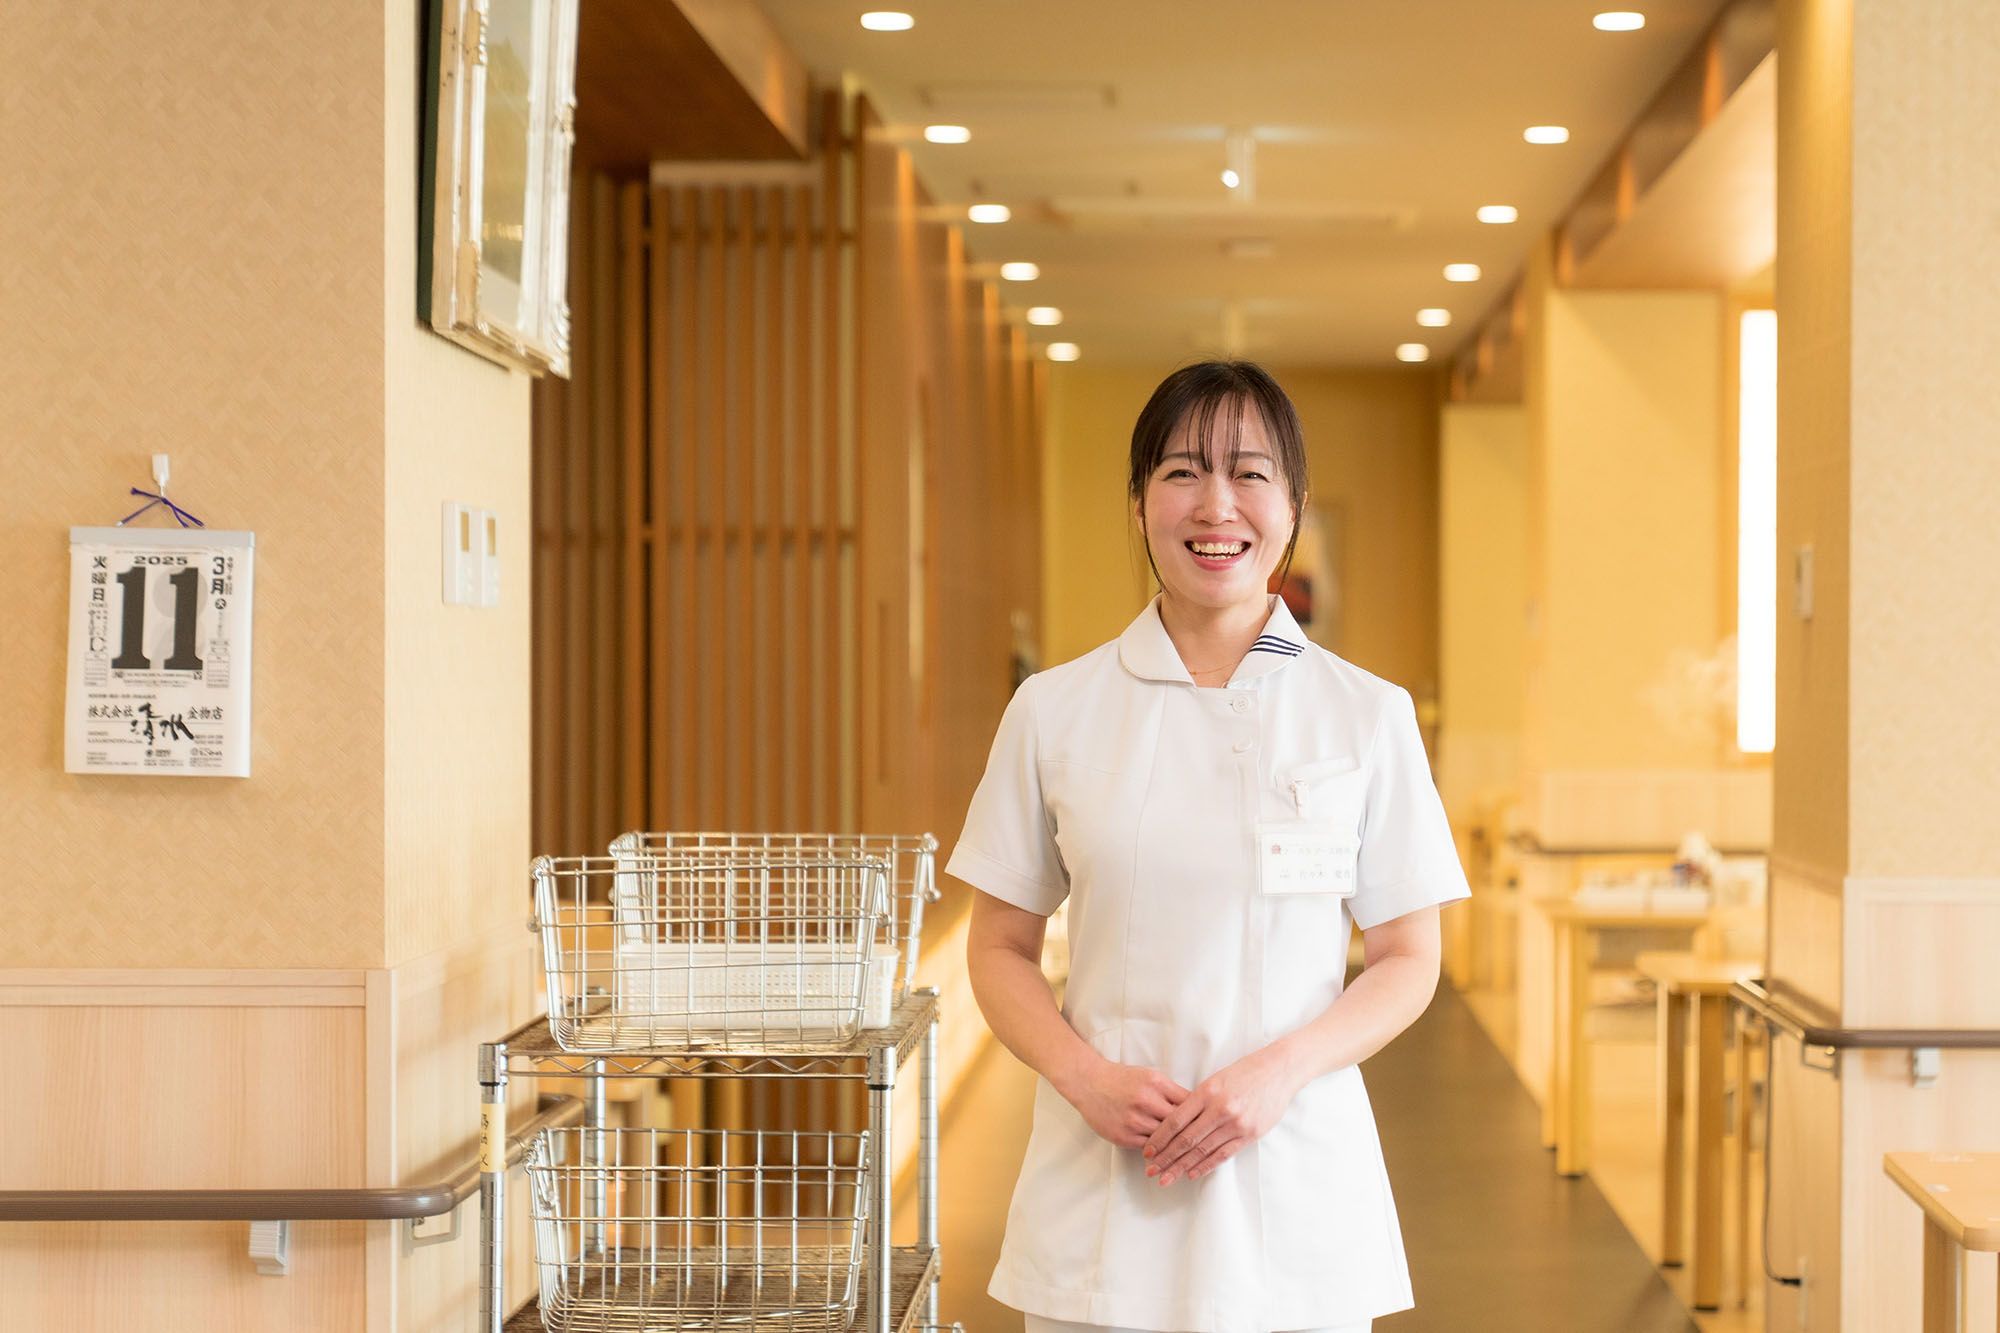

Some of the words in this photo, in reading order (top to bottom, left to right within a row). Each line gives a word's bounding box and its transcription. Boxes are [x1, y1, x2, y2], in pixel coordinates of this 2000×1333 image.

[133, 556, 188, 566] 2025
[210, 556, 225, 595] 3月
[111, 566, 203, 670] 11
